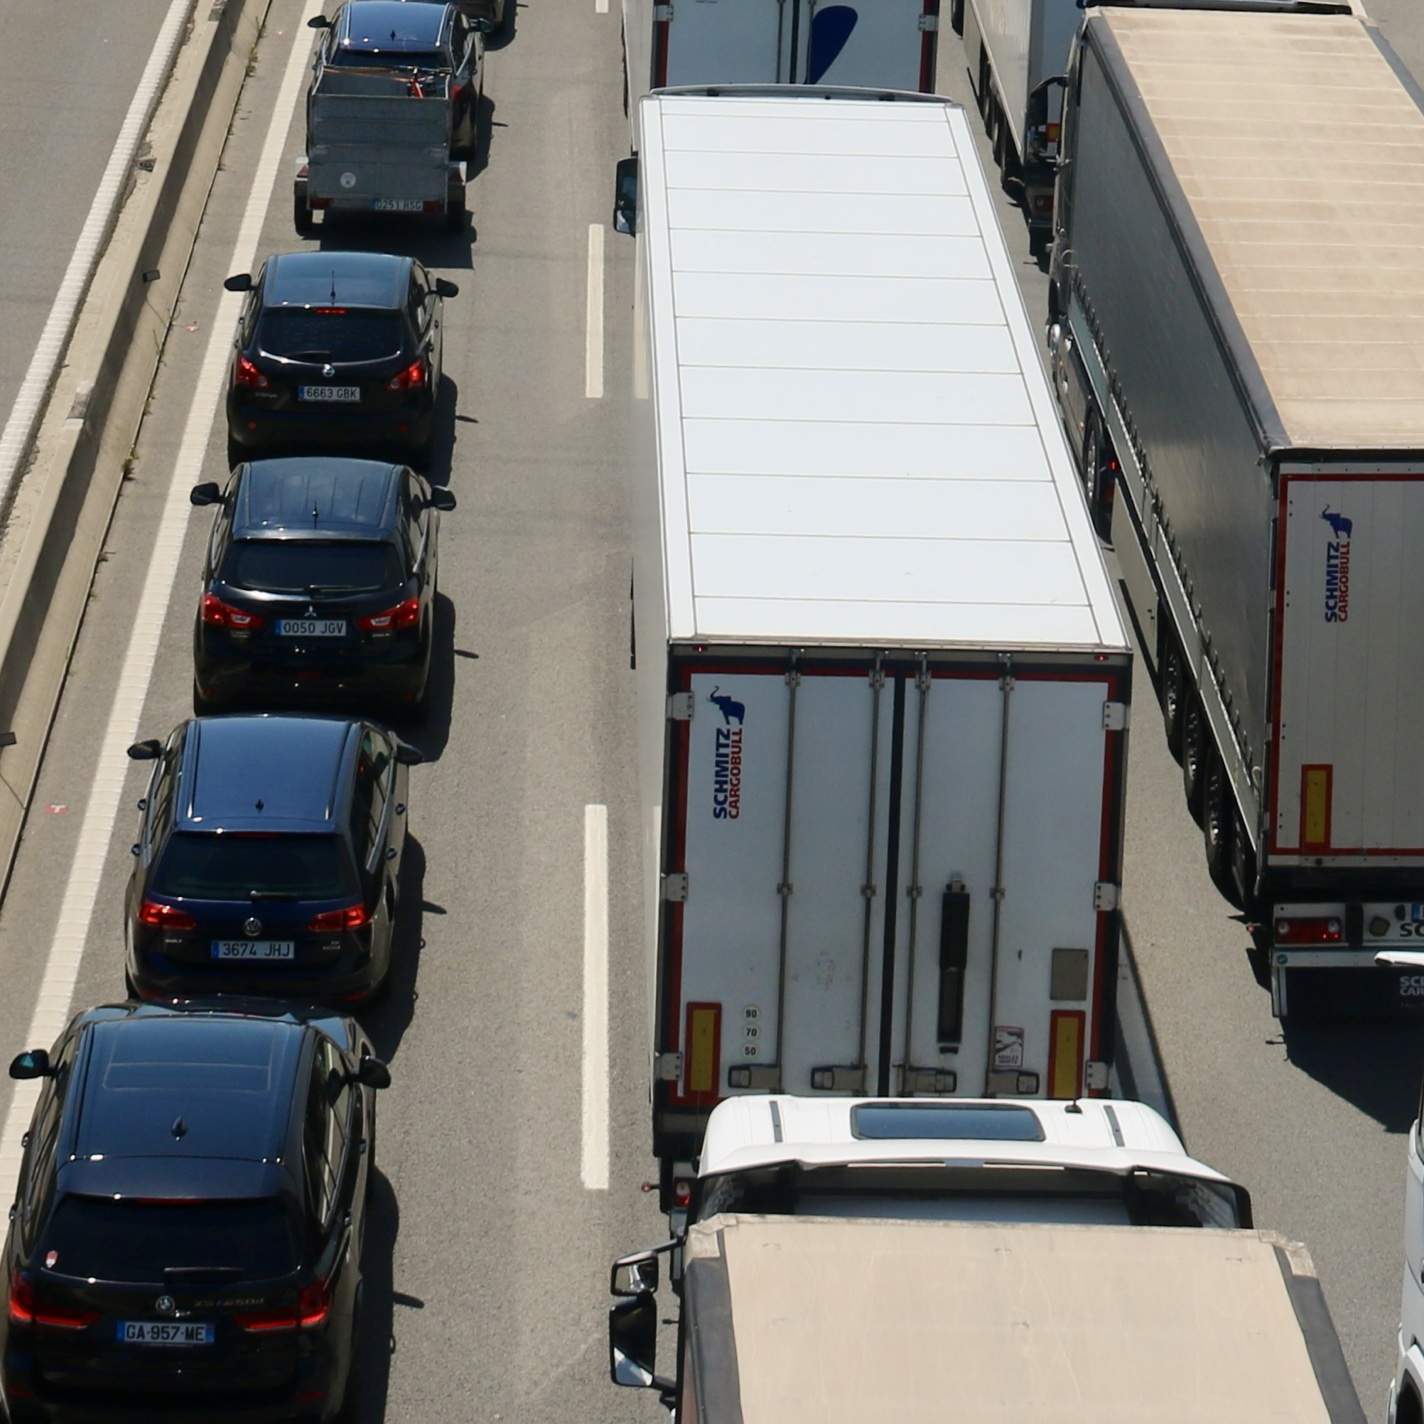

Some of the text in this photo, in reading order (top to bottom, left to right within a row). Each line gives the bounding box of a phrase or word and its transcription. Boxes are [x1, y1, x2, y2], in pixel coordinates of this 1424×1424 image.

[306, 387, 334, 399] 6663
[1324, 541, 1340, 623] SCHMITZ
[1338, 541, 1351, 623] CARGOBULL
[283, 622, 344, 634] 0050 JGV
[713, 728, 730, 820] SCHMITZ
[728, 728, 742, 820] CARGOBULL
[223, 942, 291, 958] 3674 JHJ
[746, 1026, 758, 1037] 70
[744, 1045, 757, 1056] 50
[126, 1323, 206, 1342] GA-957-ME
